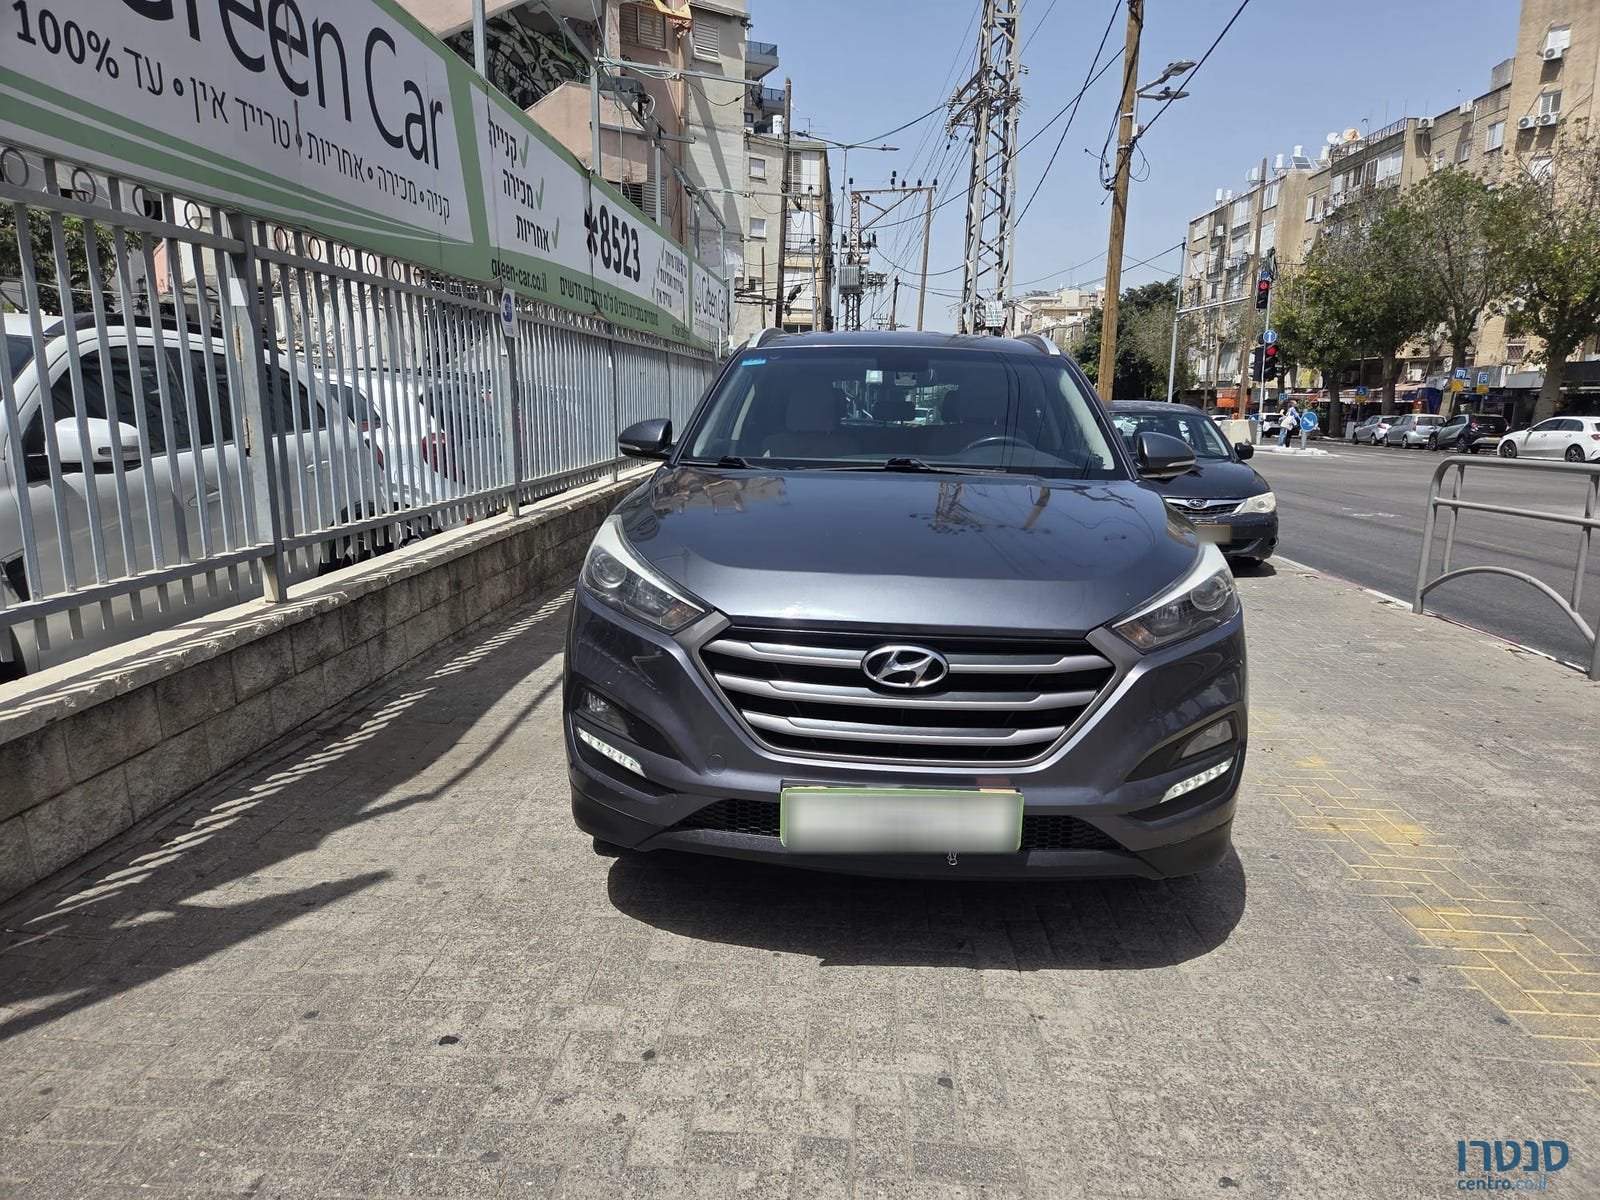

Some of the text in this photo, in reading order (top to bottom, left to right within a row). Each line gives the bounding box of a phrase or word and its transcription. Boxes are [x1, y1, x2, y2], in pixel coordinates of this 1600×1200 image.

[122, 0, 443, 170] een Car
[12, 0, 450, 225] קניה מכירה אחריות טרייד אין עד 100%
[503, 168, 534, 209] מכירה
[516, 214, 550, 253] אחריות
[560, 275, 582, 303] חדשים
